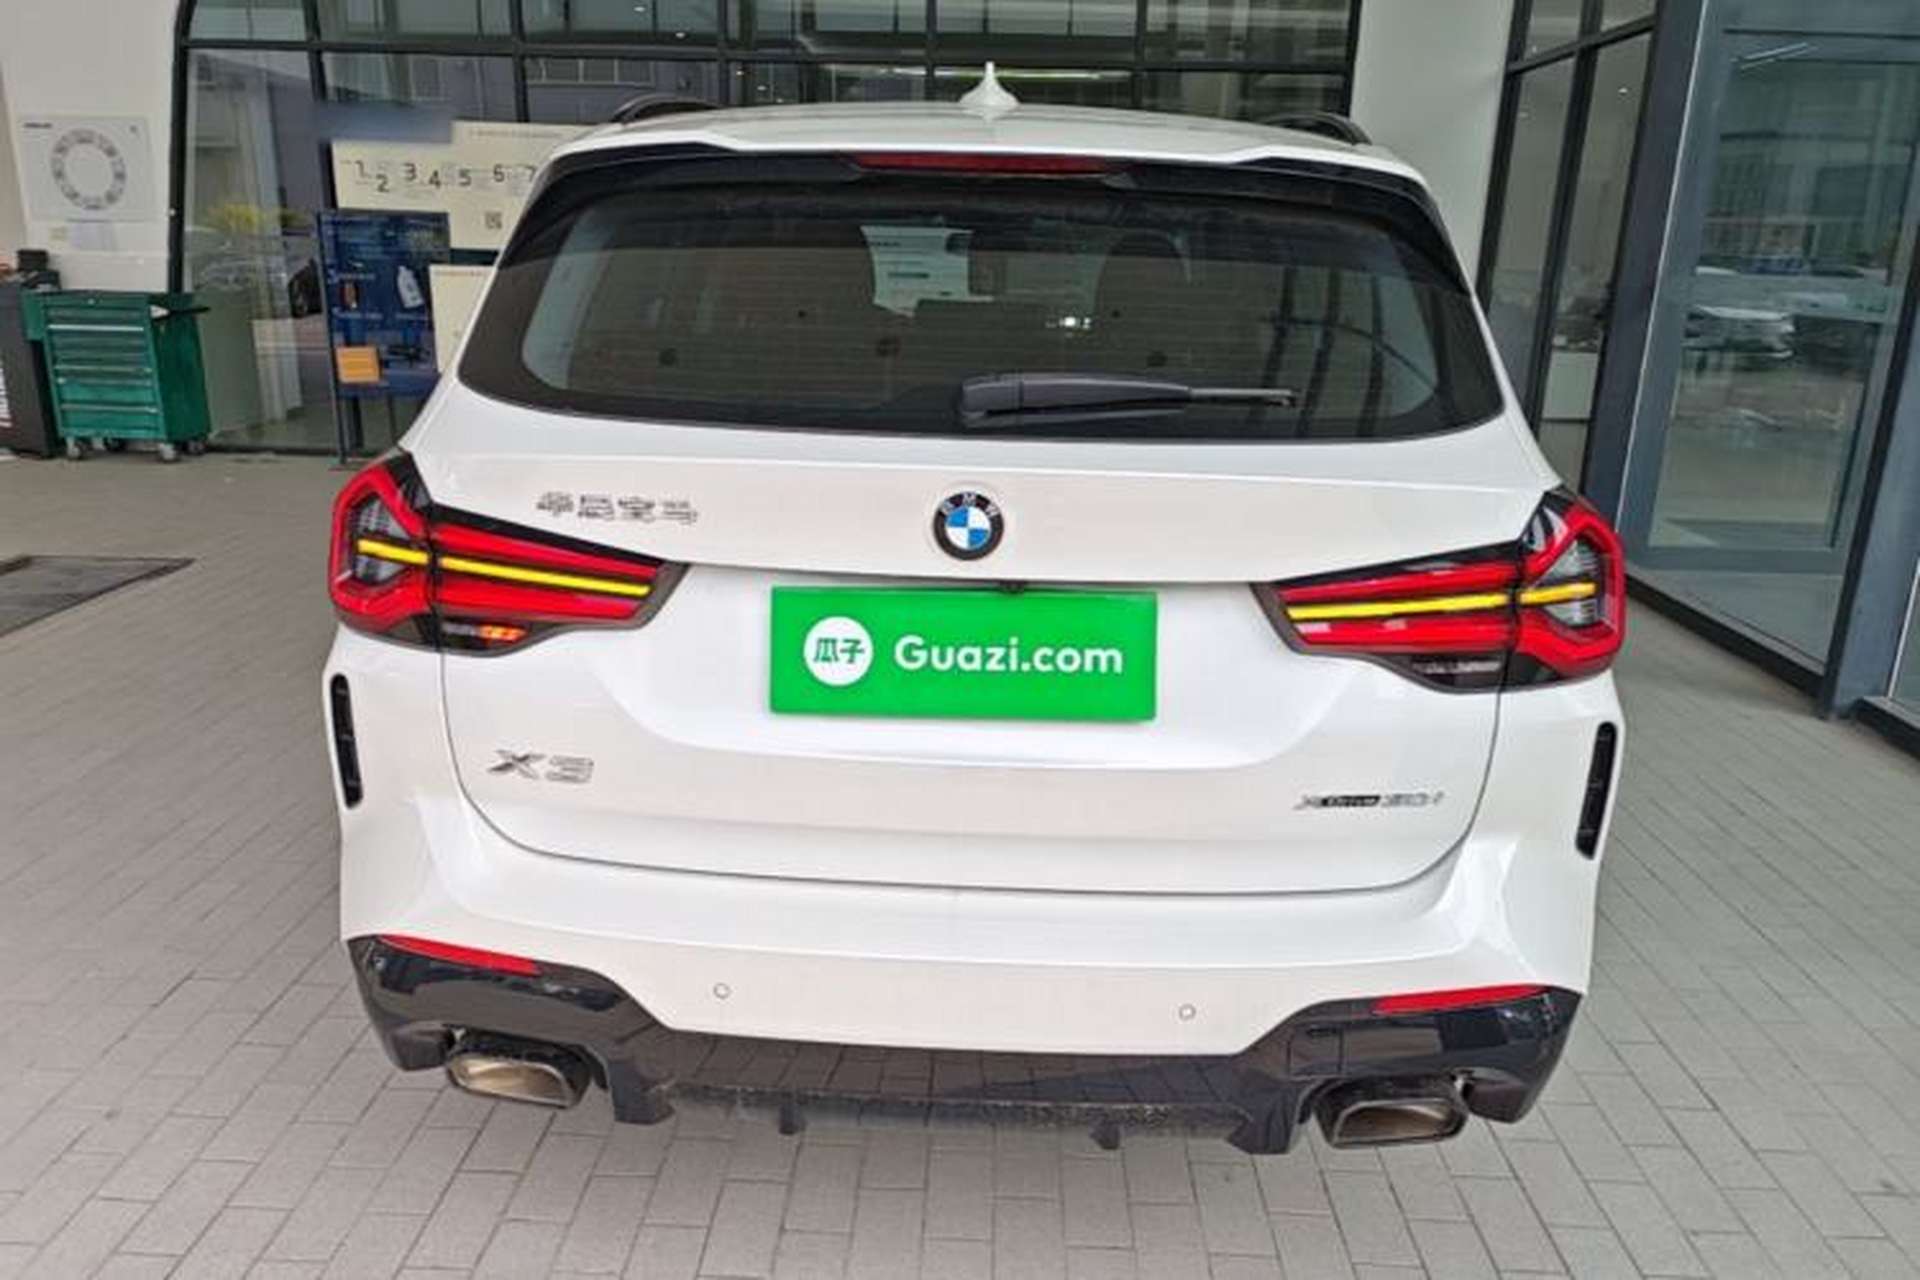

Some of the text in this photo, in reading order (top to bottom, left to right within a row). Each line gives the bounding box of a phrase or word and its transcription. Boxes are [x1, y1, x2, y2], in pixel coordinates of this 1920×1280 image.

[375, 173, 390, 192] 2
[402, 162, 417, 181] 3
[428, 170, 441, 189] 4
[458, 168, 472, 187] 5
[493, 164, 505, 183] 6
[812, 636, 866, 665] 瓜子
[893, 633, 1123, 675] Guazi.com
[487, 749, 595, 784] X3
